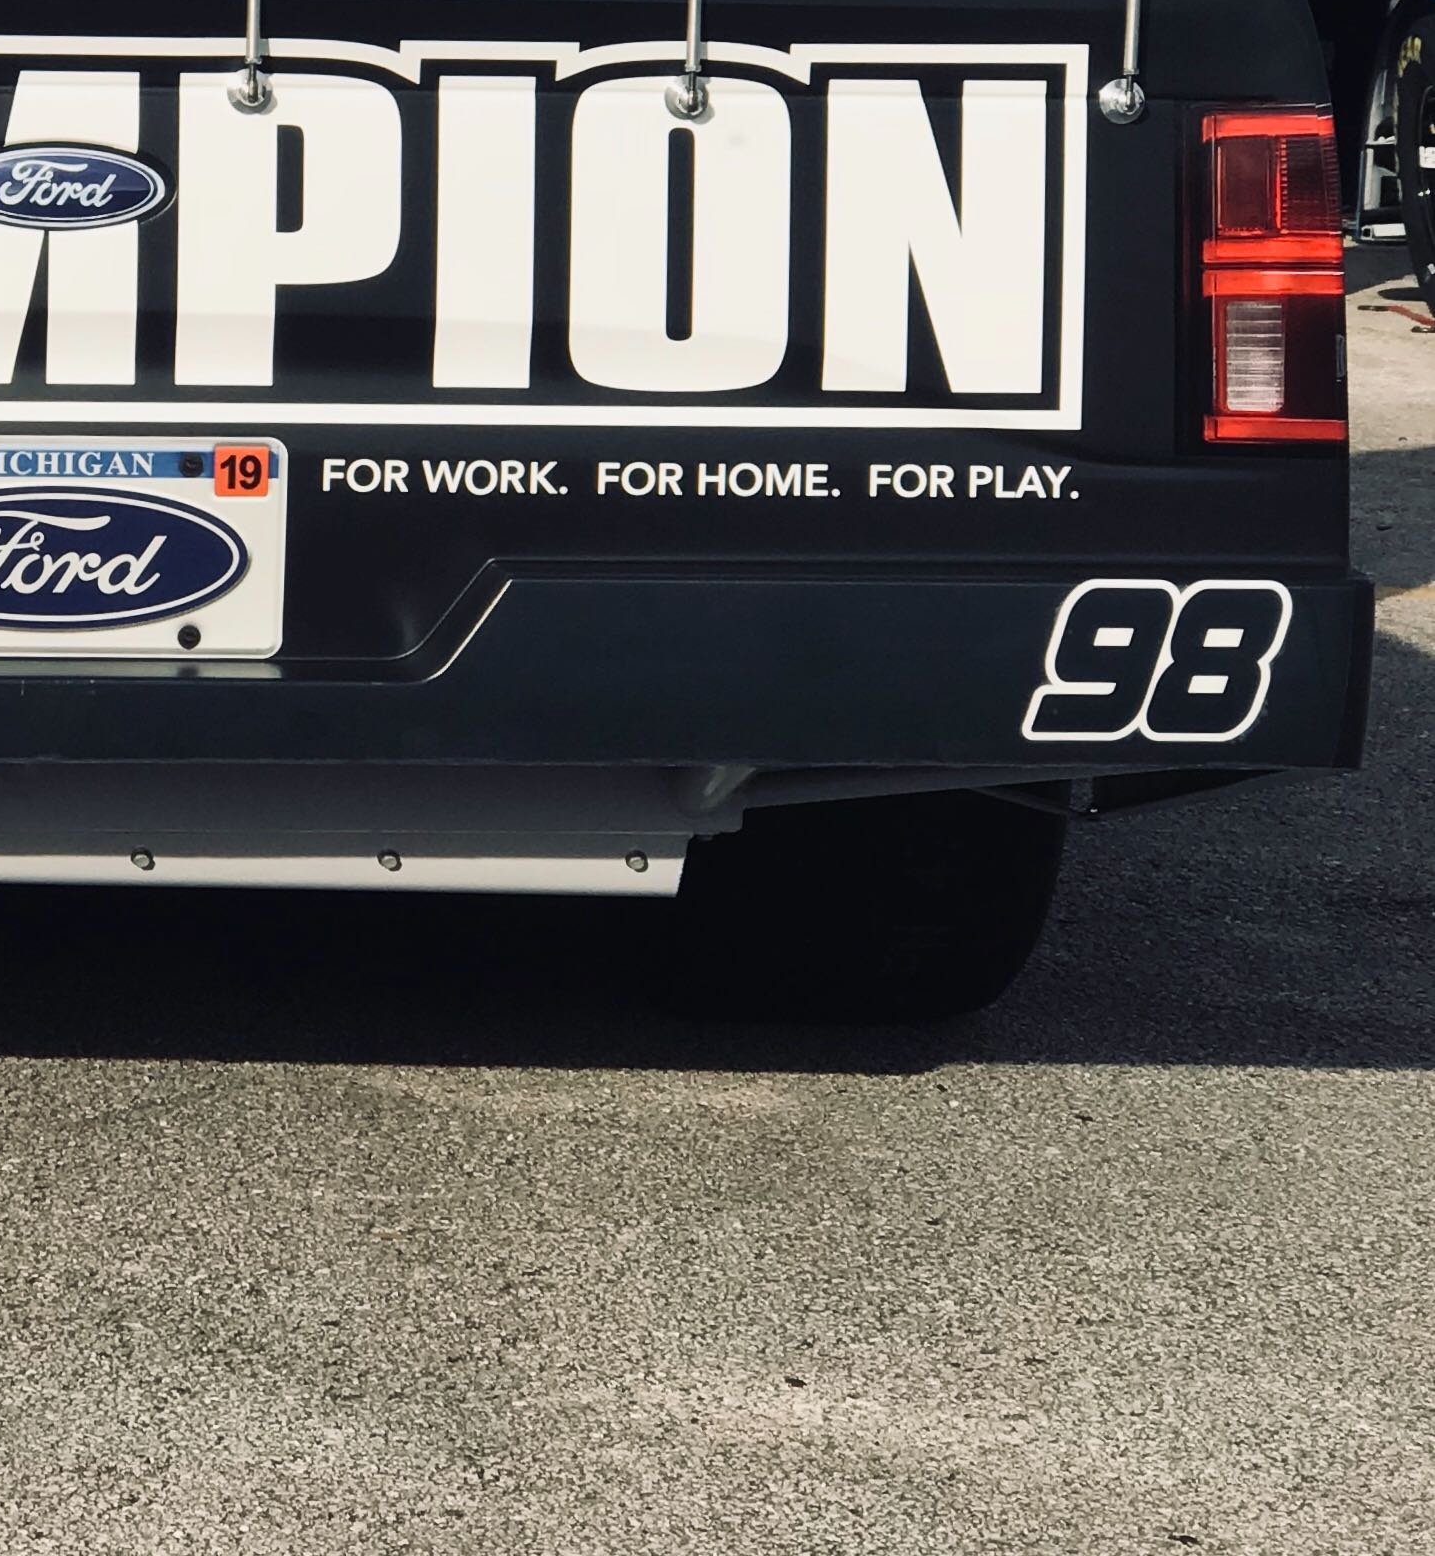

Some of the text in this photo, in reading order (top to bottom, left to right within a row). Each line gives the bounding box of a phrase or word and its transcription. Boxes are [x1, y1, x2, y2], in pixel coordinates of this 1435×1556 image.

[220, 454, 262, 490] 19
[322, 458, 1079, 500] FOR WORK. FOR HOME. FOR PLAY.
[1021, 578, 1293, 742] 98
